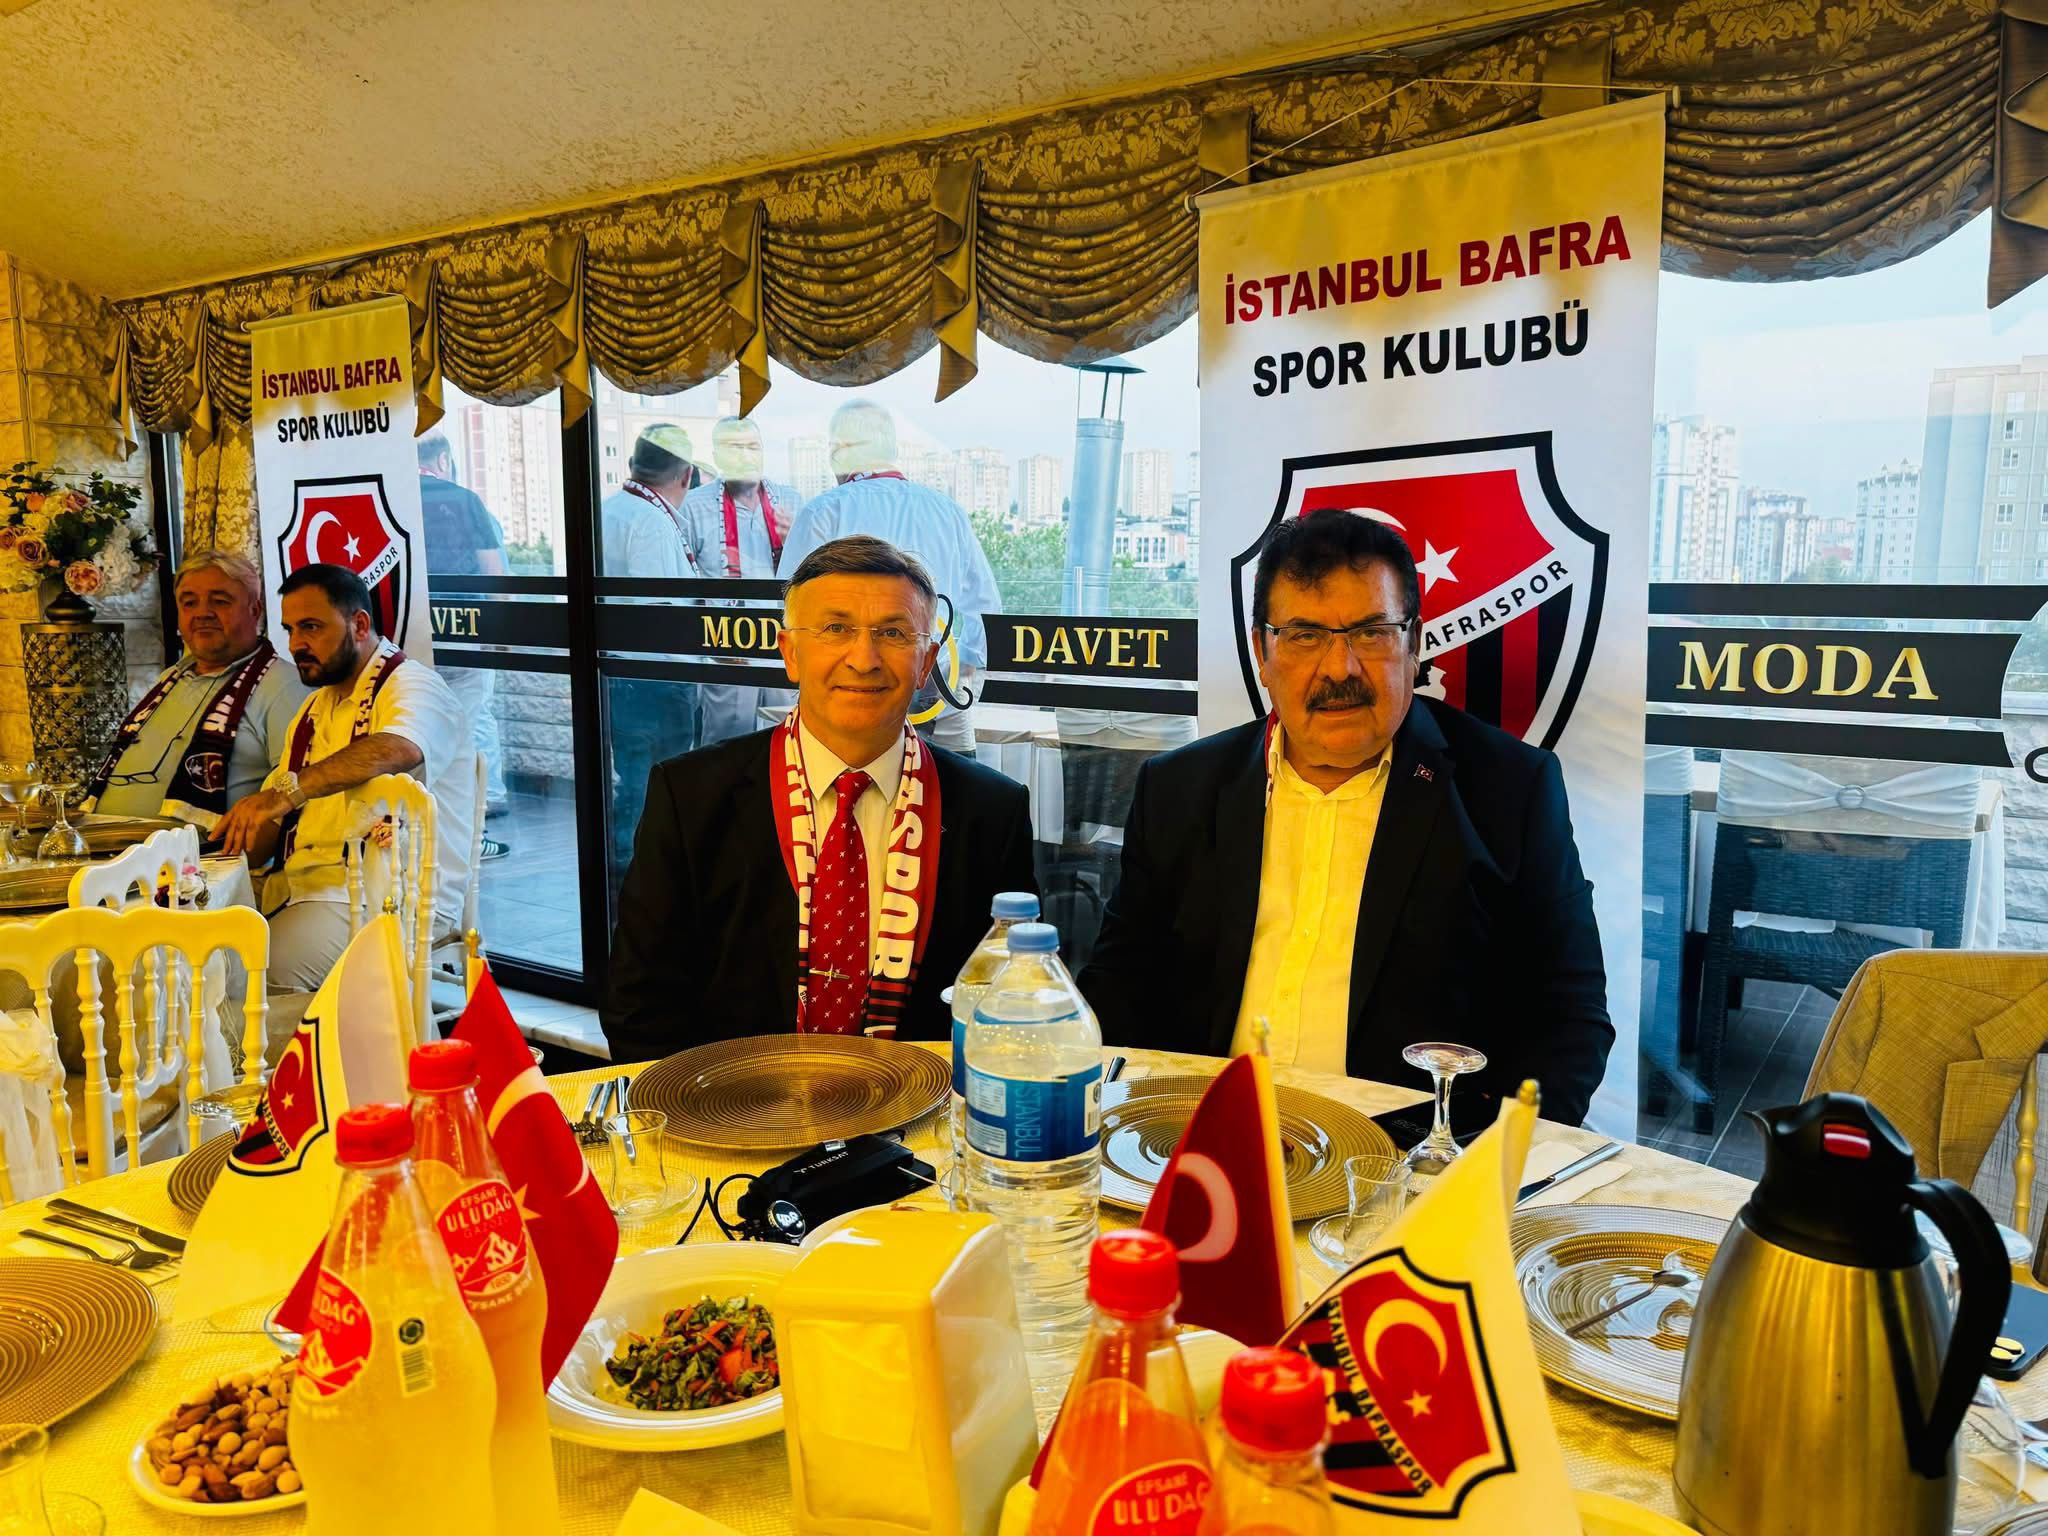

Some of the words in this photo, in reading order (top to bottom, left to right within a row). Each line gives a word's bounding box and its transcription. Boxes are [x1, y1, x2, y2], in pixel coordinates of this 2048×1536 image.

[1225, 249, 1442, 325] İSTANBUL
[1460, 215, 1631, 287] BAFRA
[262, 368, 340, 399] İSTANBUL
[344, 356, 402, 389] BAFRA
[1253, 341, 1368, 397] SPOR
[1384, 299, 1589, 379] KULUBÜ
[277, 415, 320, 443] SPOR
[323, 402, 390, 439] KULUBÜ
[701, 614, 780, 651] MOD
[1425, 560, 1568, 651] AFRASPOR
[1012, 625, 1169, 669] DAVET
[1676, 641, 1939, 700] MODA
[1354, 1387, 1434, 1498] BAFRASPOR
